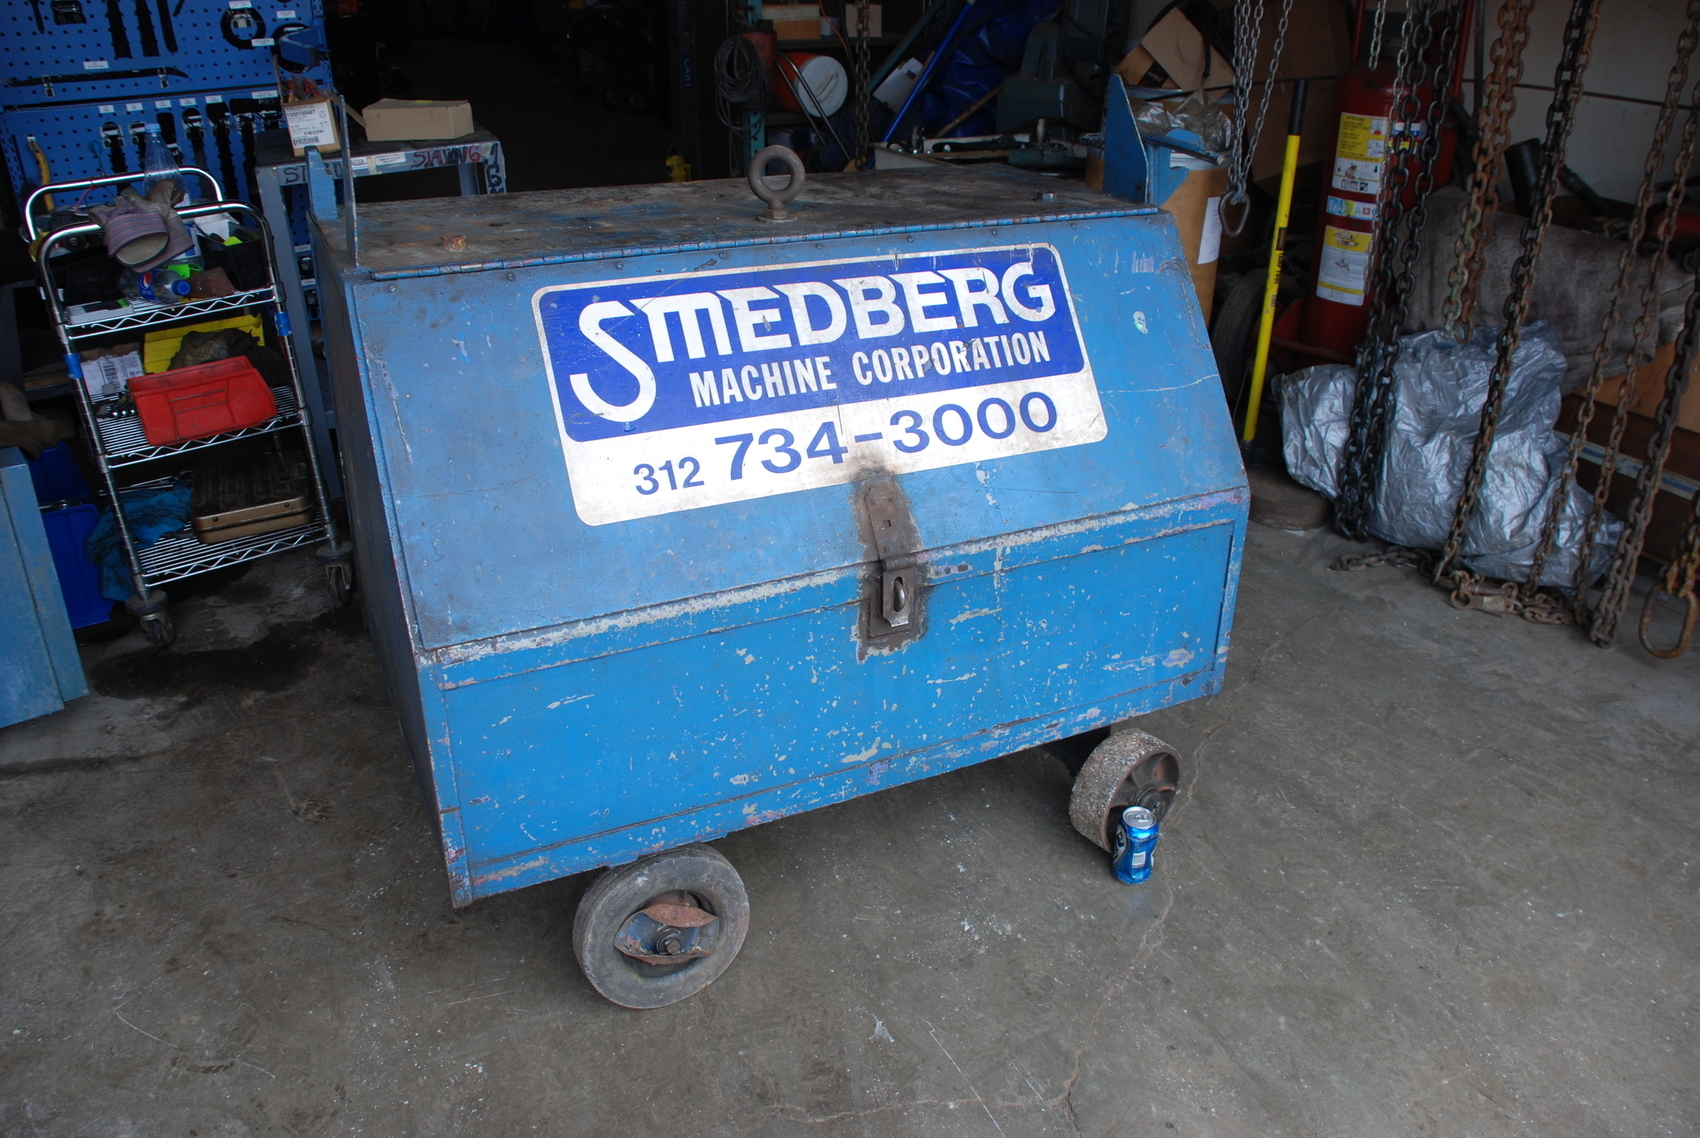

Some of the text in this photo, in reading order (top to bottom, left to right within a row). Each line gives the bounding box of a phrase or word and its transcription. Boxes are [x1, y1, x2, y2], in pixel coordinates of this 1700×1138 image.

[569, 261, 1057, 423] SMEDBERG
[688, 330, 1051, 408] MACHINE CORPORATION
[633, 391, 1058, 496] 312 734-3000
